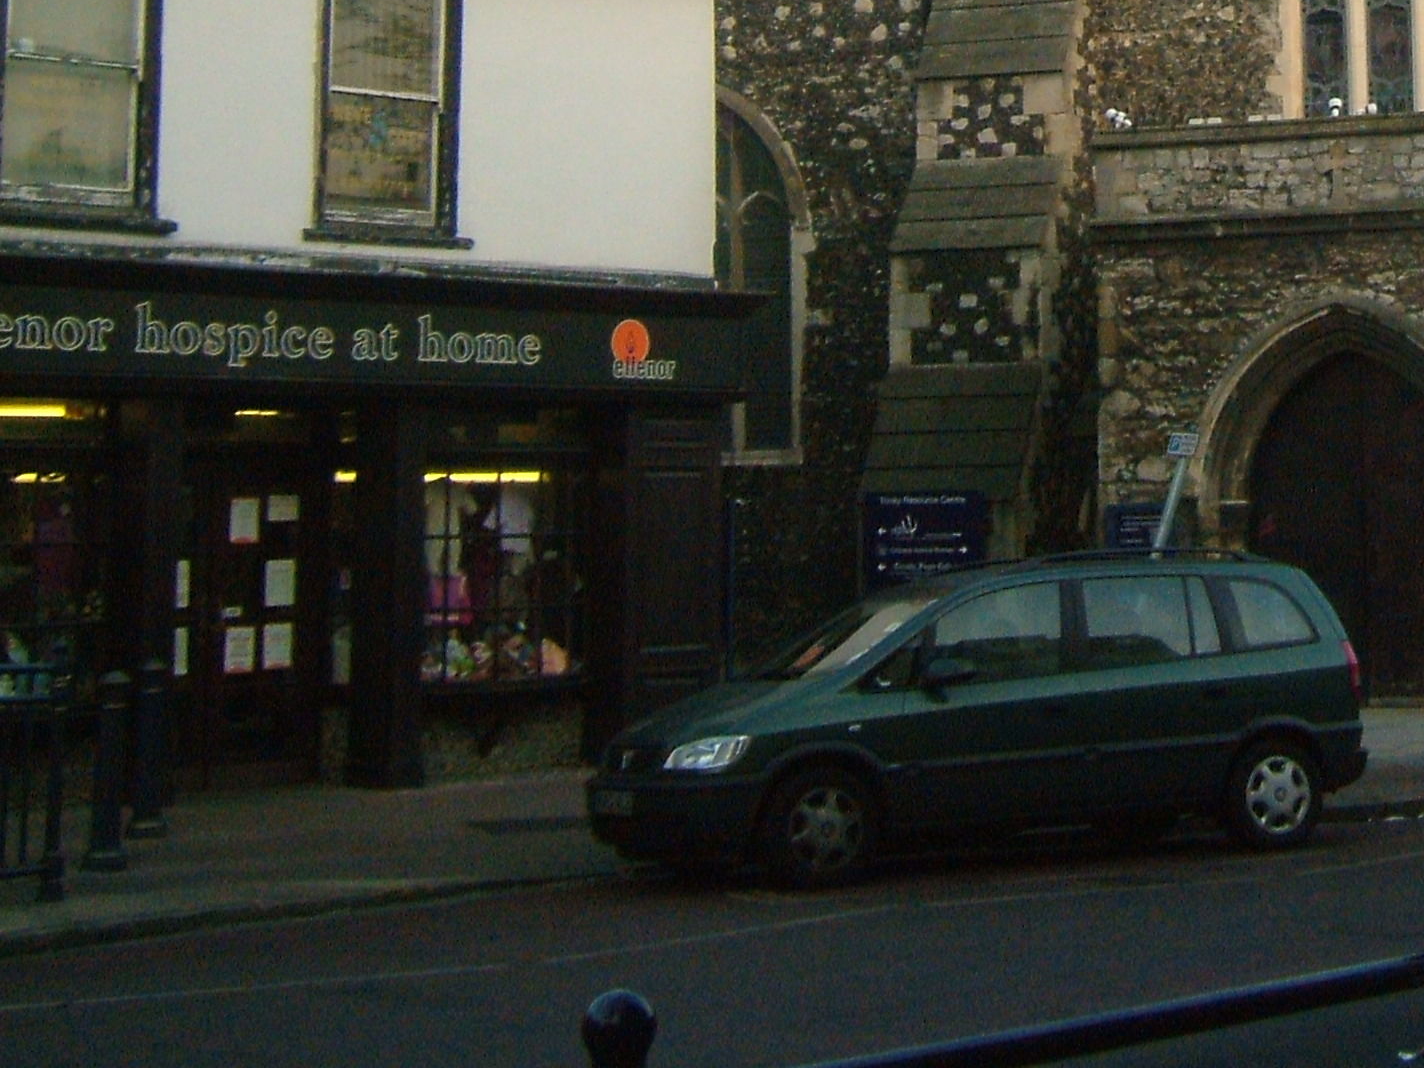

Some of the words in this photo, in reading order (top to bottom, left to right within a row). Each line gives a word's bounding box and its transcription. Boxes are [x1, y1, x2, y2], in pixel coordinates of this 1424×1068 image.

[134, 301, 335, 367] hospice
[352, 323, 399, 361] at
[417, 314, 542, 365] home
[612, 356, 677, 380] ellenor
